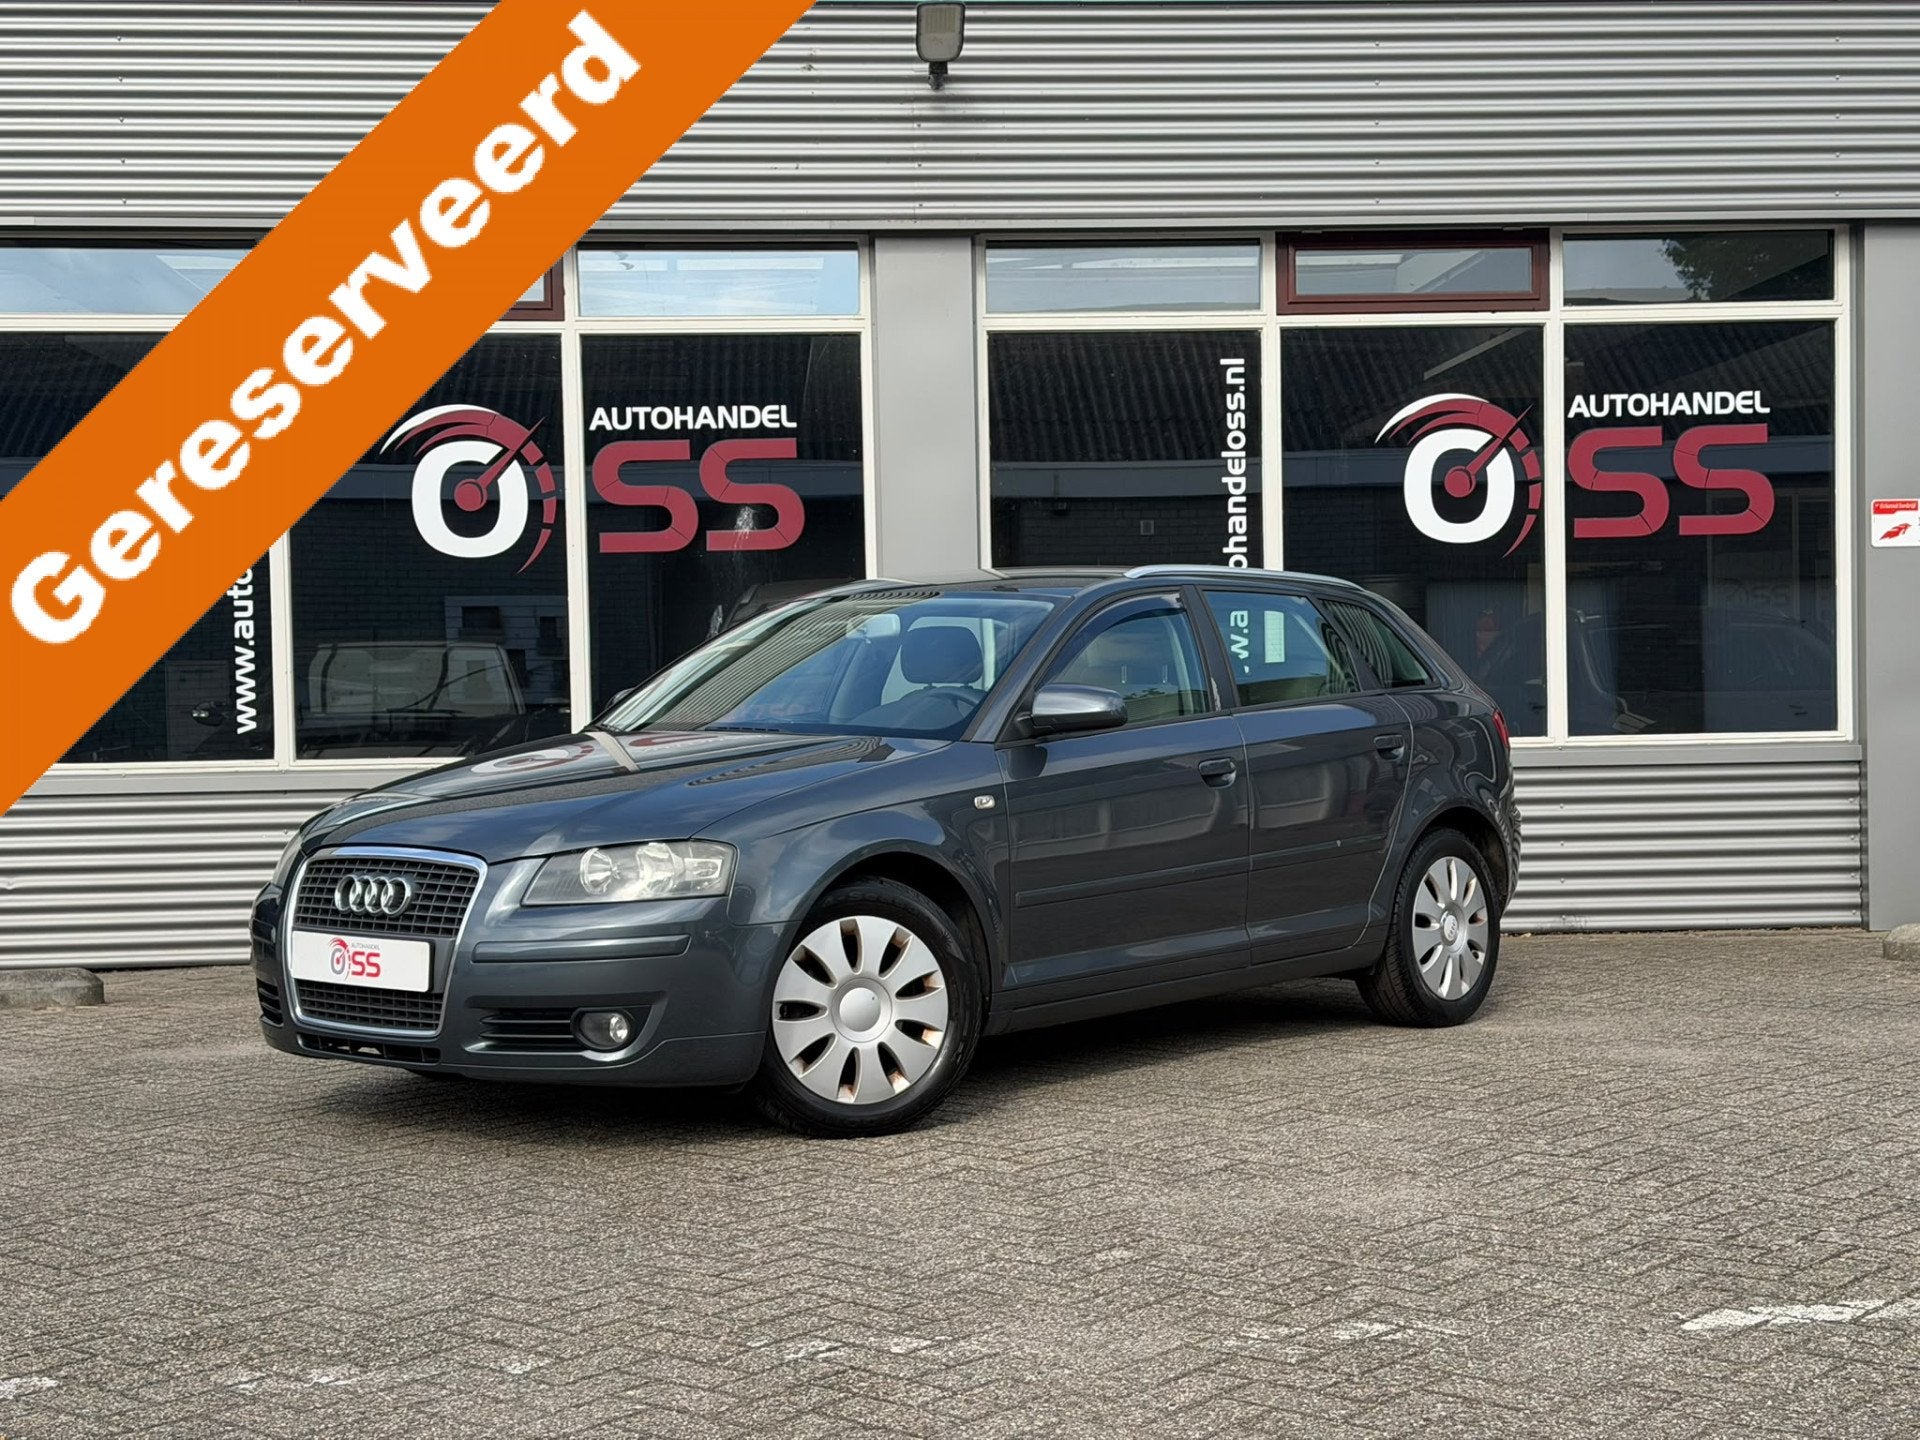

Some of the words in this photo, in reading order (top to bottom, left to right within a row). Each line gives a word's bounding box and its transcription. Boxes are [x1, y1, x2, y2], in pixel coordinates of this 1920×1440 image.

[588, 404, 798, 431] AUTOHANDEL
[1567, 390, 1771, 419] AUTOHANDEL
[411, 437, 806, 558] OSS
[1403, 422, 1775, 544] OSS
[330, 947, 381, 978] OSS
